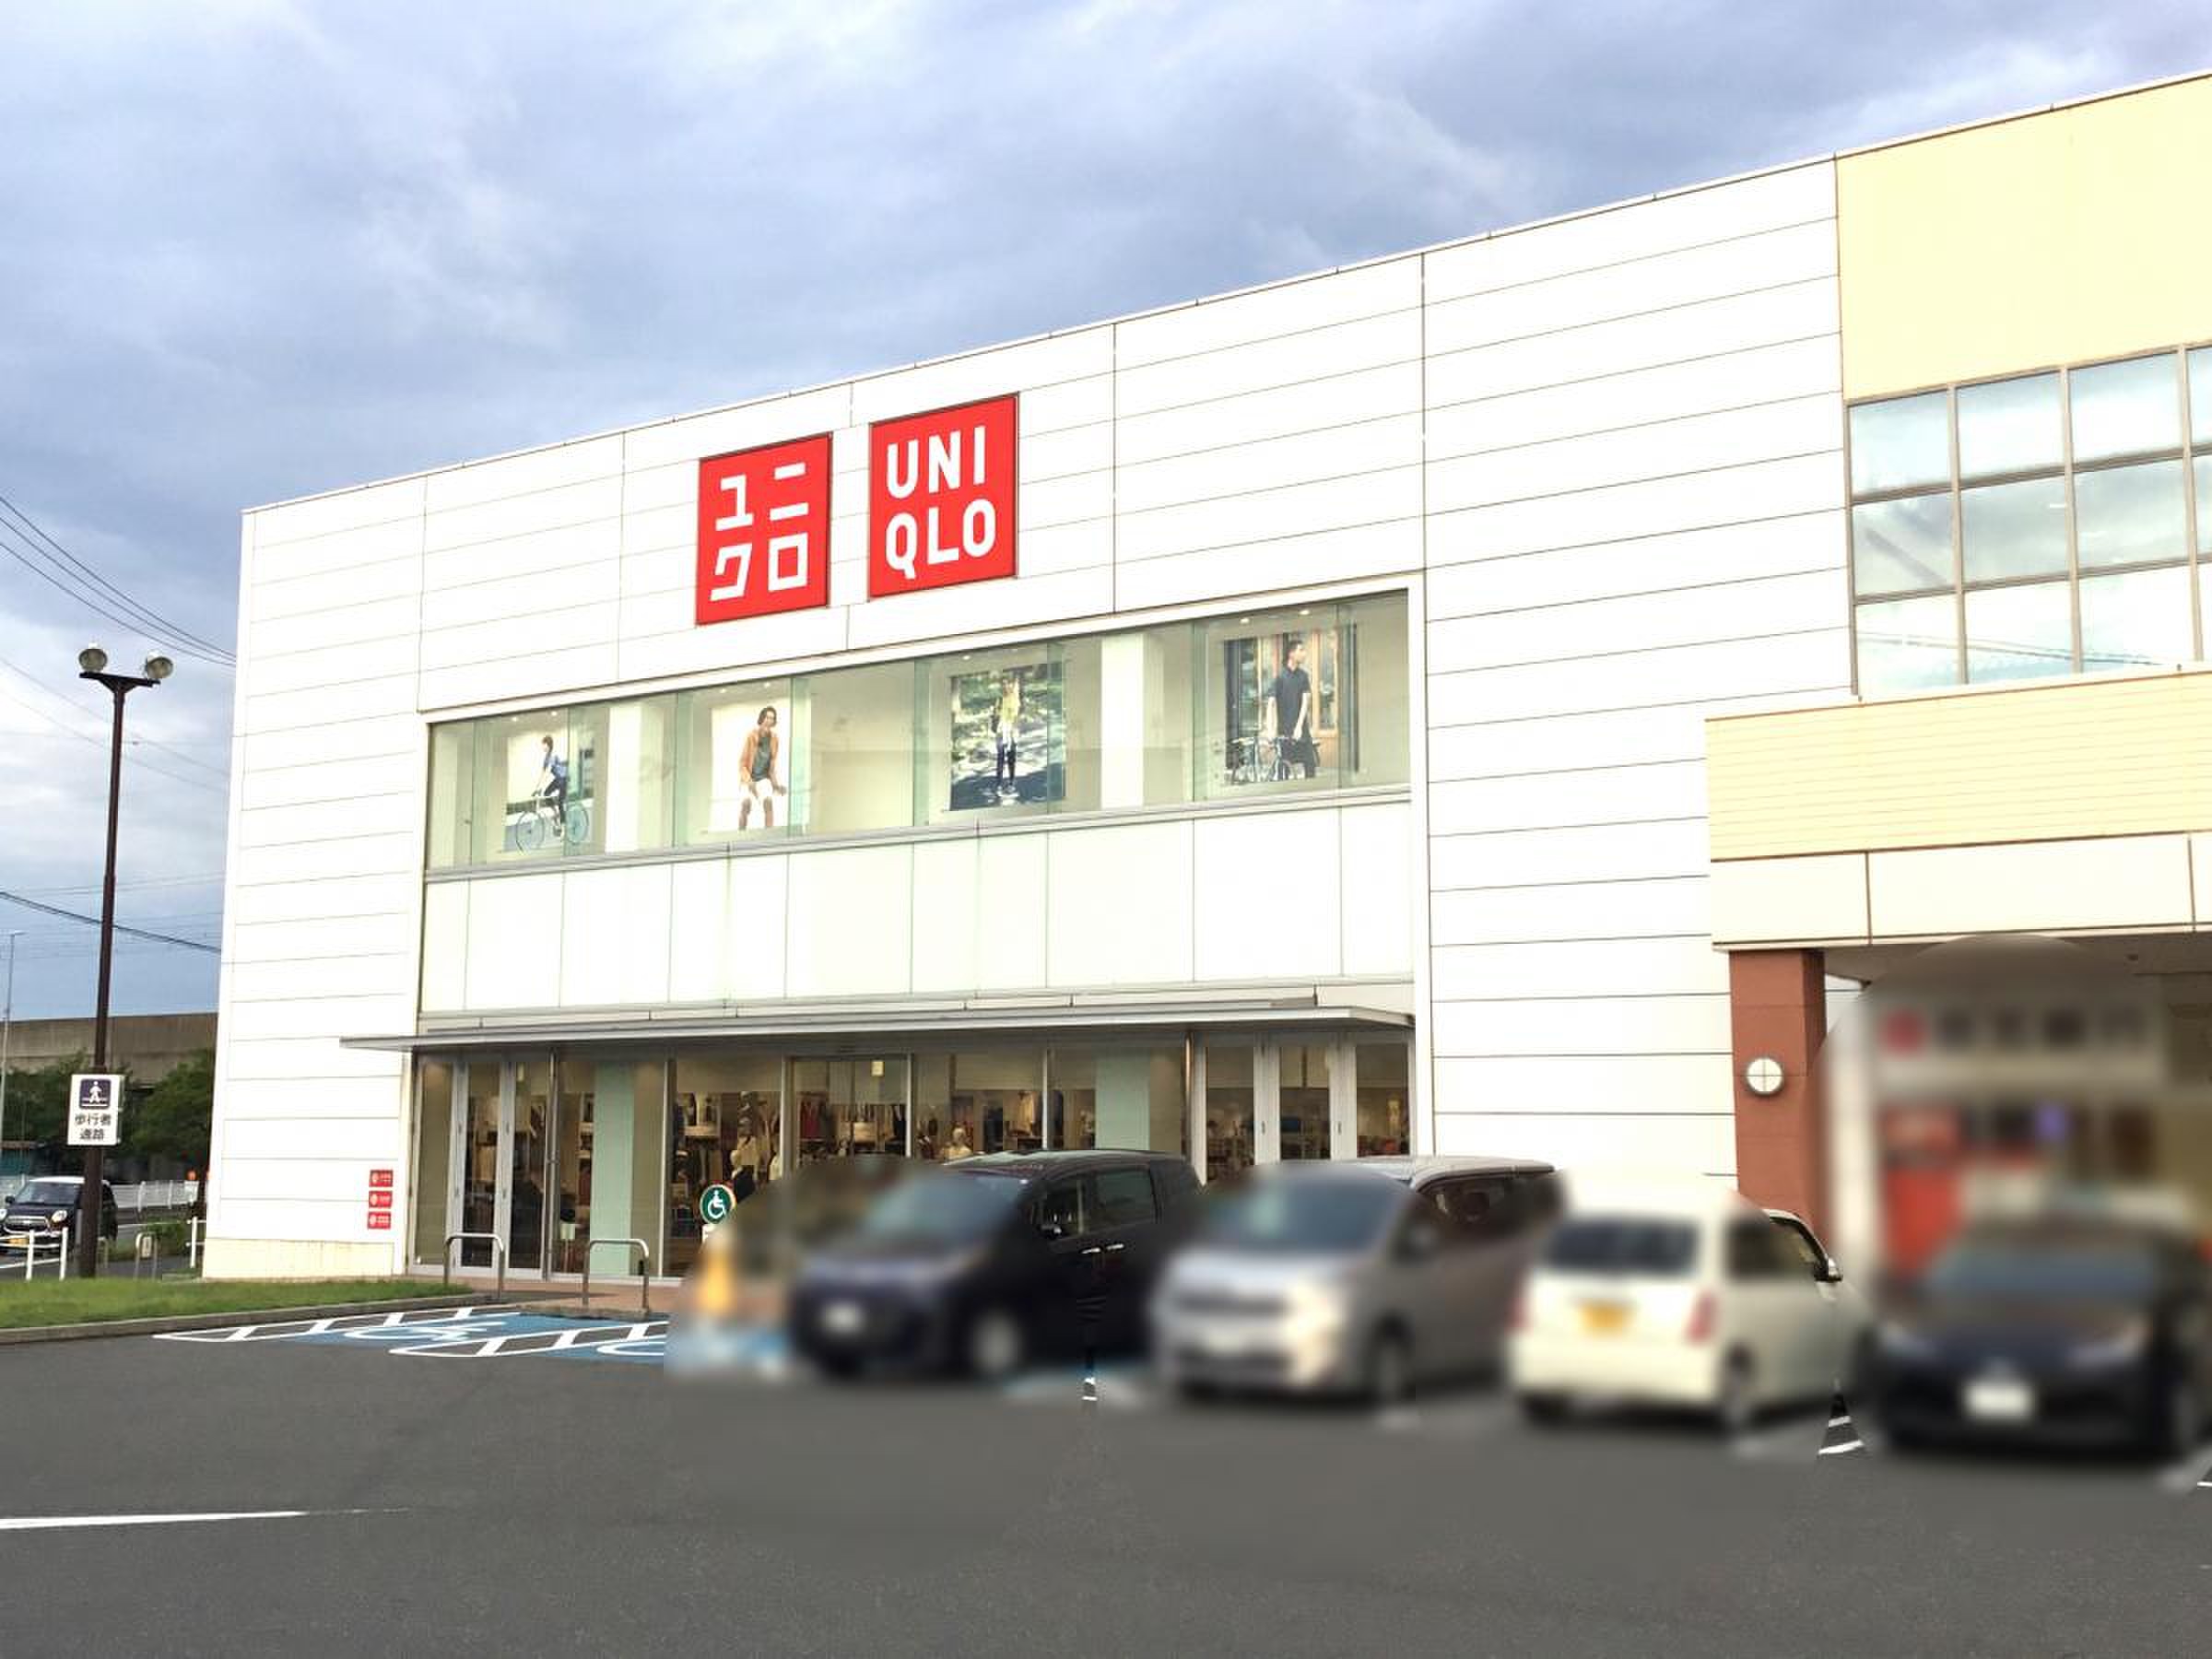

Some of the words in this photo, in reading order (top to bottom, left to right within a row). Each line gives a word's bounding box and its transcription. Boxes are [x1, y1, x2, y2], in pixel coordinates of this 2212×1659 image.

[715, 462, 809, 532] ユニ
[887, 425, 986, 499] UNI
[710, 532, 808, 602] クロ
[885, 498, 996, 580] QLO
